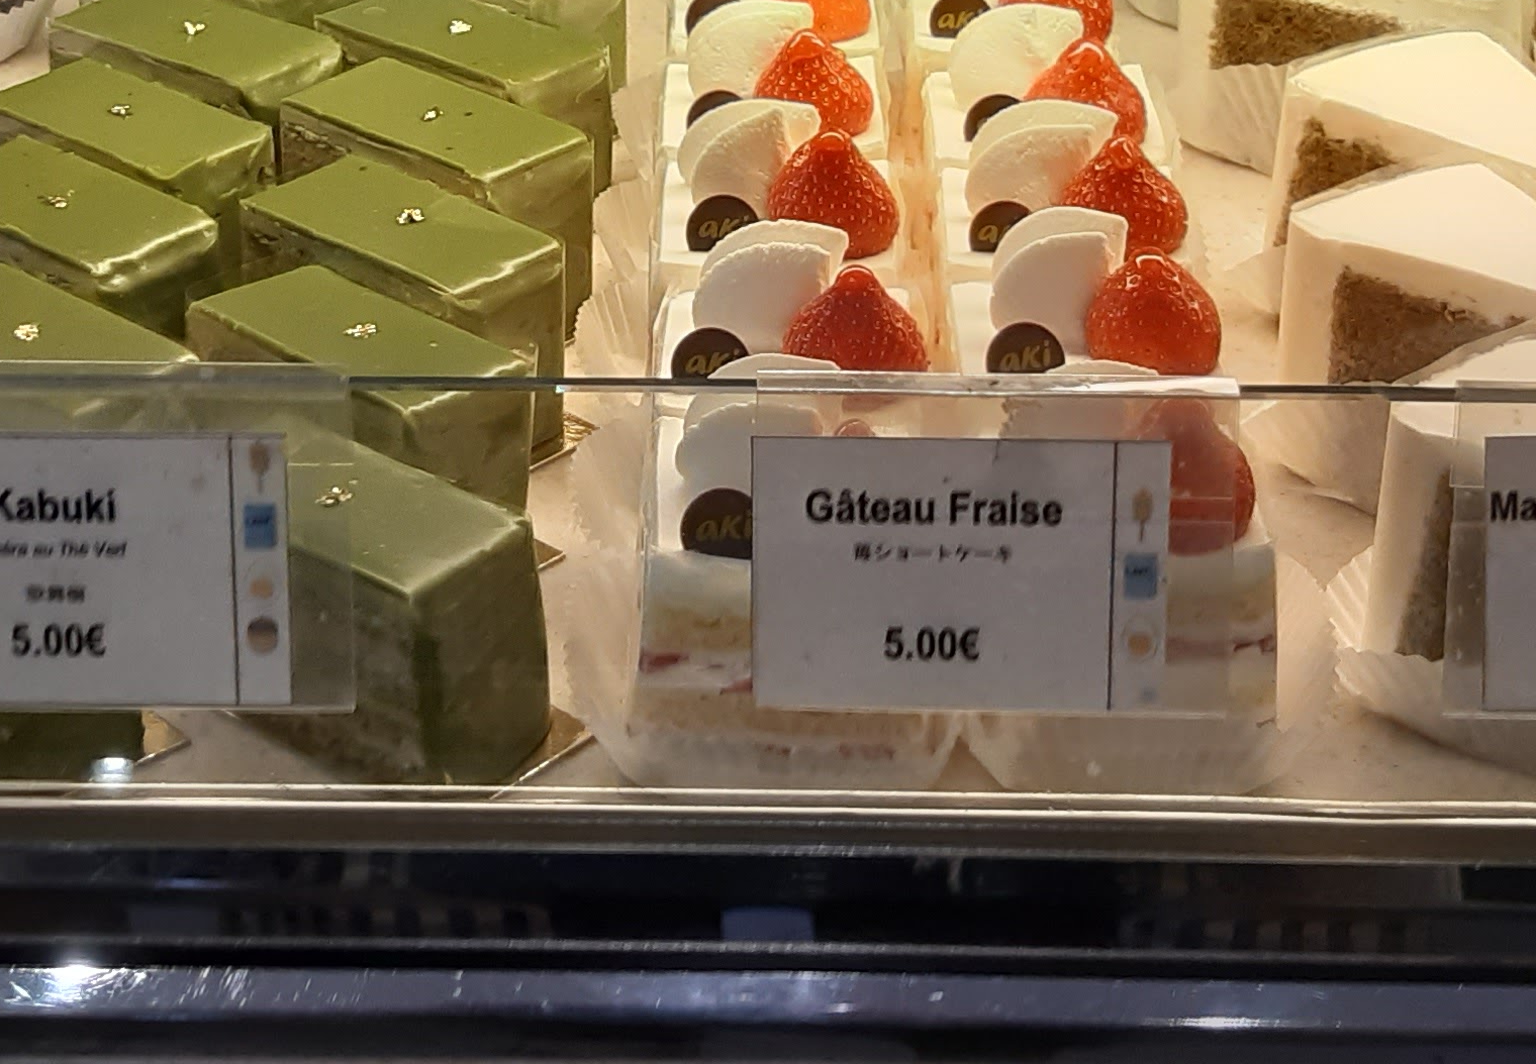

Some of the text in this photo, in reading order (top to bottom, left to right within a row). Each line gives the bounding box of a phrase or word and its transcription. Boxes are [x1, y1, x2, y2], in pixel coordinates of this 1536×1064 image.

[806, 487, 1064, 528] Gâteau Fraise
[11, 623, 109, 658] 5.00€
[883, 625, 981, 662] 5.00€
